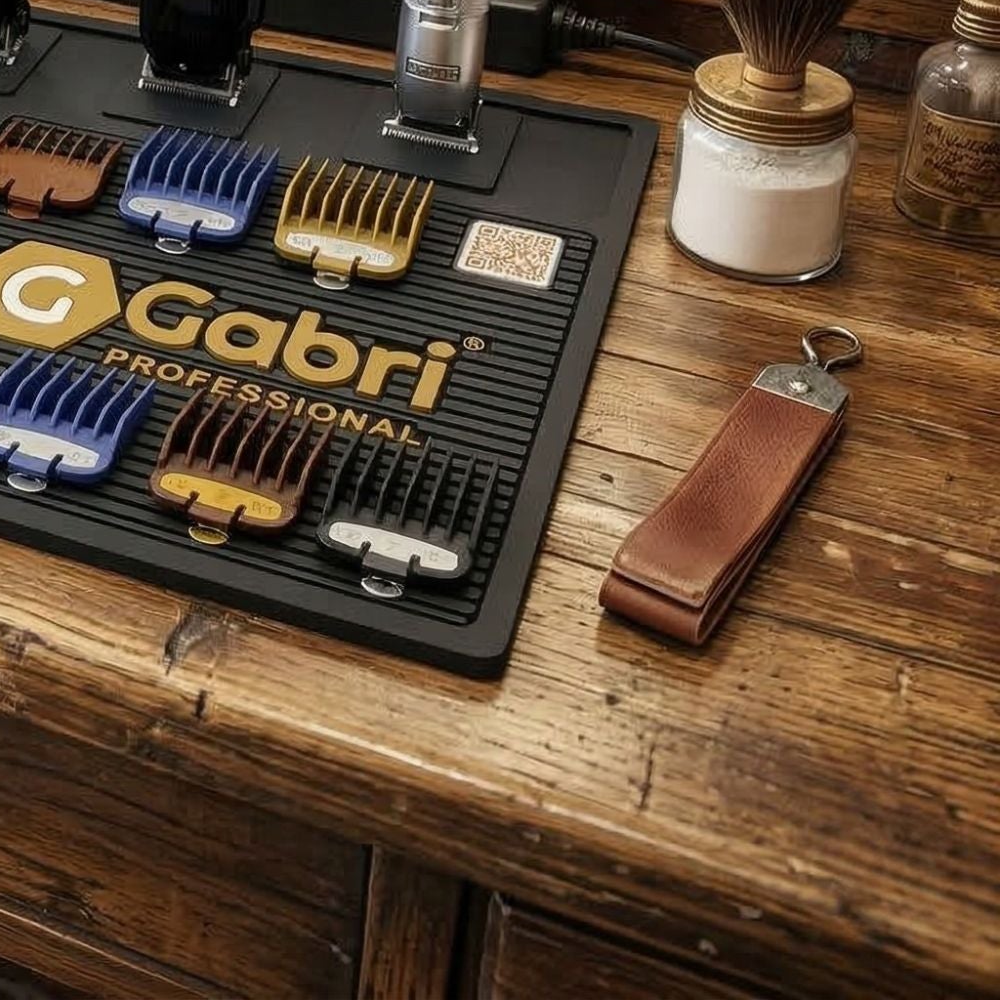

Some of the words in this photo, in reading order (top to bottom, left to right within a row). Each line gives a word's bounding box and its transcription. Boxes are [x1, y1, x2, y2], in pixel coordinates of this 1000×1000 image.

[1, 265, 88, 325] G
[125, 280, 458, 413] Gabri
[104, 348, 421, 446] PROFESSIONAL
